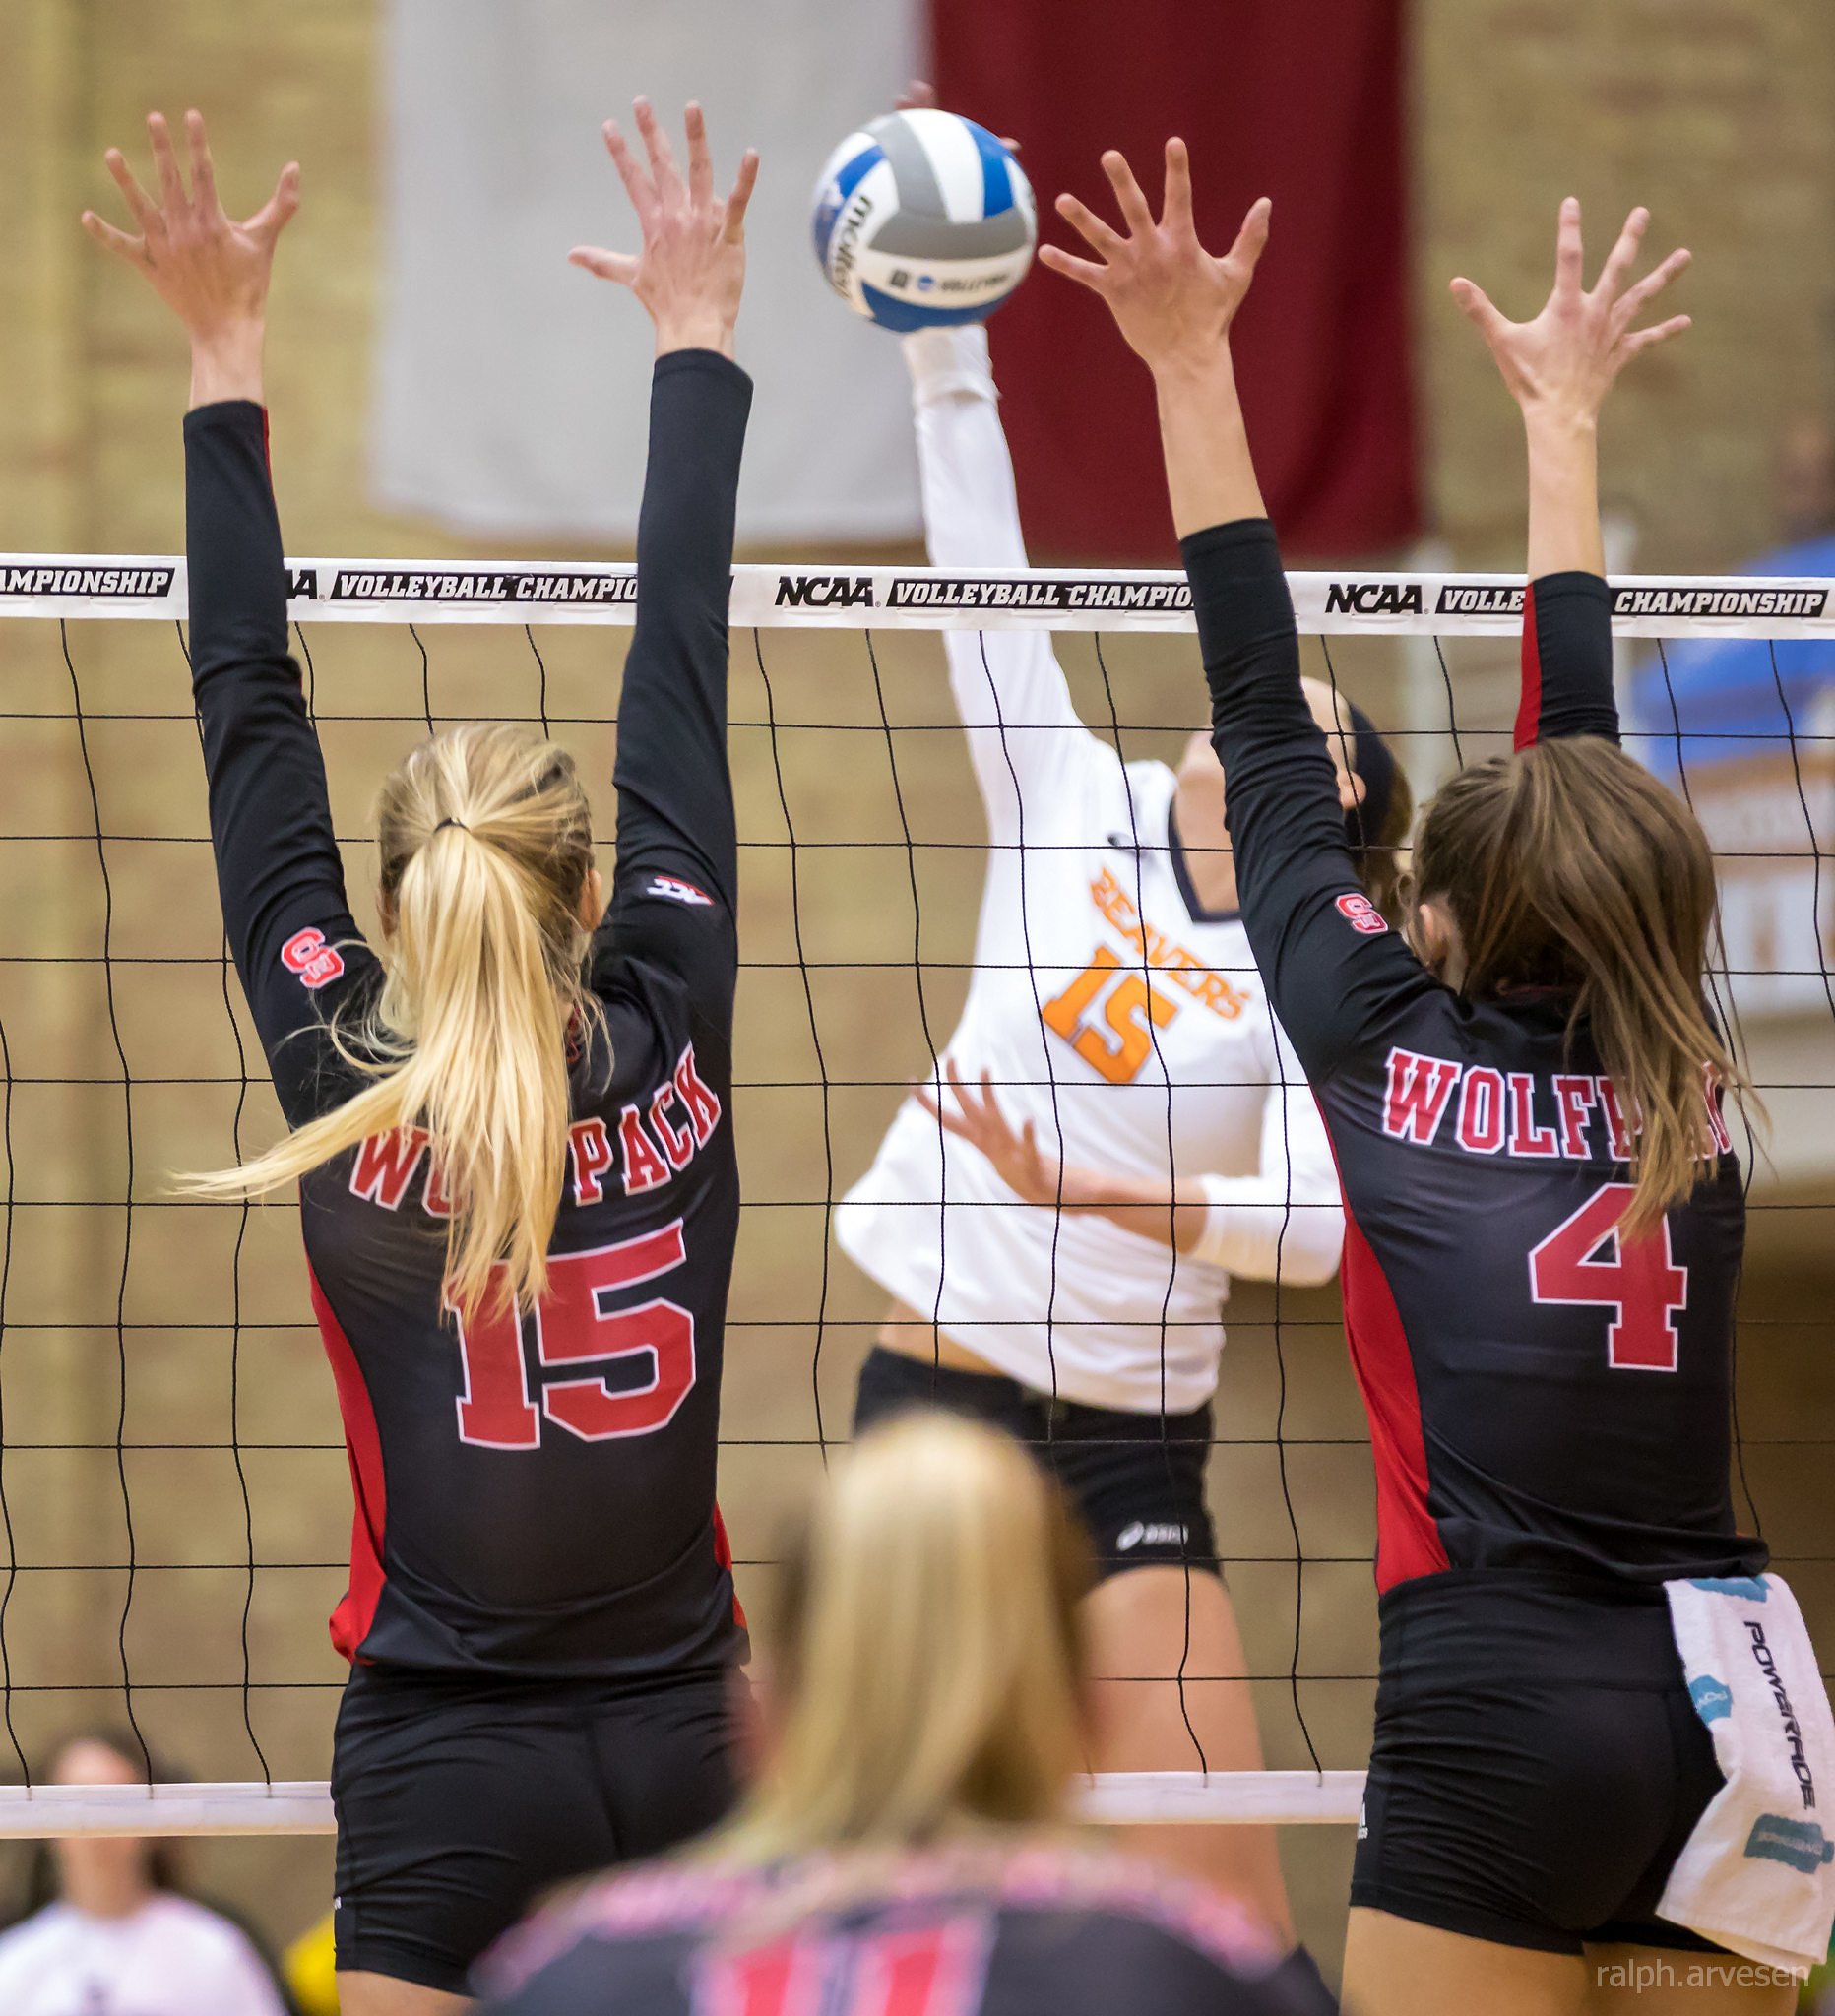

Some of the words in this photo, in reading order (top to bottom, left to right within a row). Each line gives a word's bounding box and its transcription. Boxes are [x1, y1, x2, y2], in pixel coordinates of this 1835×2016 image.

[340, 574, 508, 598] VOLLEYBALL
[775, 575, 874, 607] NCAA
[896, 582, 1061, 606] VOLLEYBALL
[1325, 583, 1423, 614] NCAA
[1614, 591, 1823, 614] CHAMPIONSHIP
[1041, 942, 1180, 1085] 15
[1089, 865, 1254, 1022] BEAVERS
[442, 1217, 697, 1452] 15
[1527, 1181, 1689, 1373] 4
